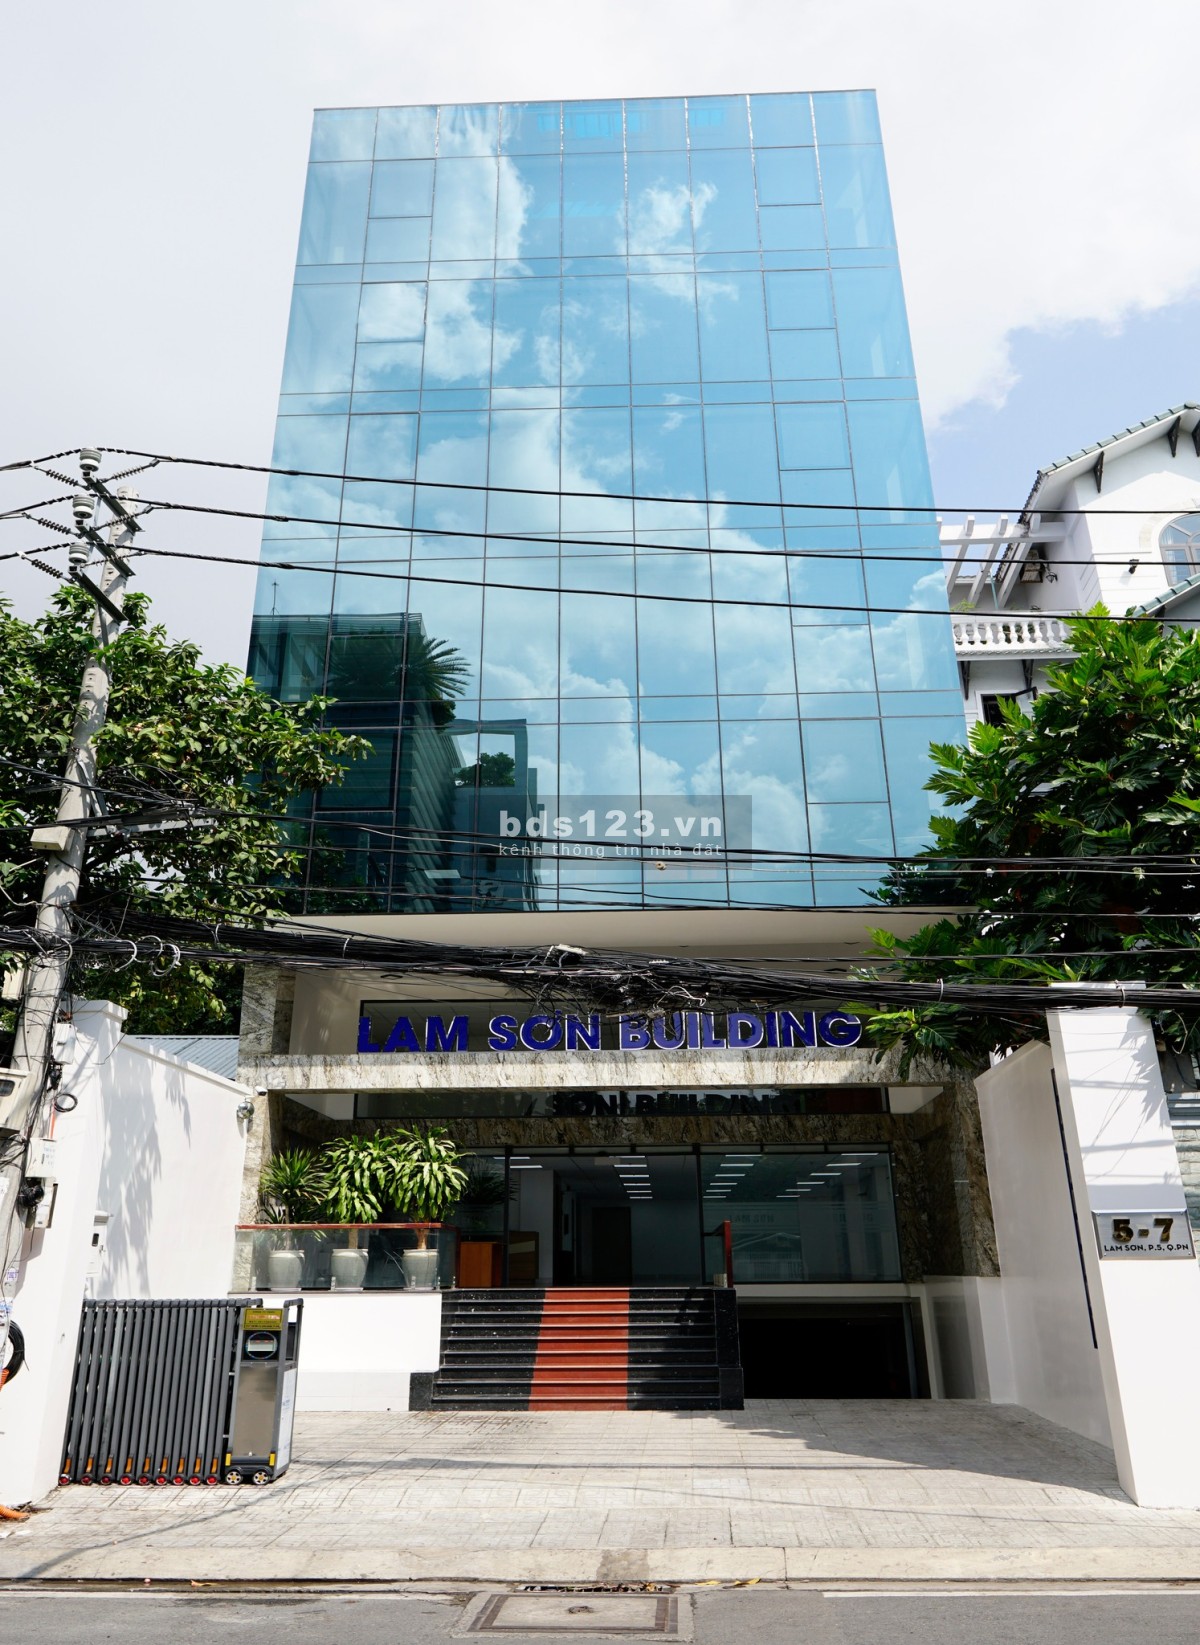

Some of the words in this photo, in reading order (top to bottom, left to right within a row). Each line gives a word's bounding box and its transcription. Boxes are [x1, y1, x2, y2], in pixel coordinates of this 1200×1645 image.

[357, 1015, 469, 1053] LAM
[619, 1011, 863, 1050] BUILDING
[1104, 1244, 1122, 1252] LAM
[1167, 1243, 1189, 1251] Q.PN
